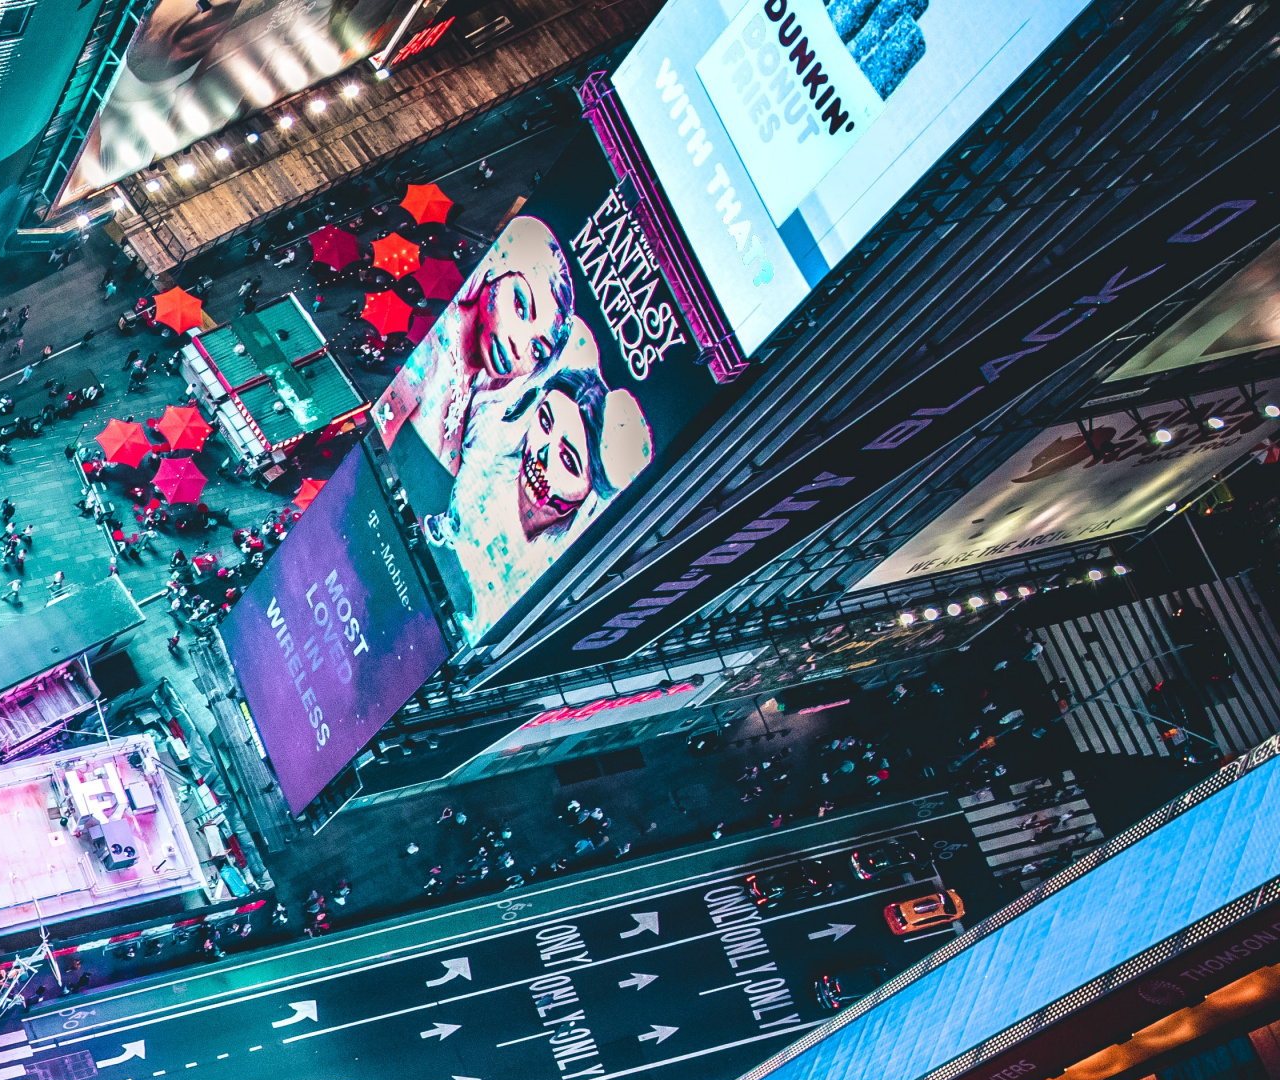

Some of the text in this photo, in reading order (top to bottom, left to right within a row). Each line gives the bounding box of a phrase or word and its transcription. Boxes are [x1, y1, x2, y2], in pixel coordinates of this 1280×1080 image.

[721, 39, 781, 143] FRIES
[742, 13, 820, 144] DONUT
[764, 0, 855, 136] DUNKIN'
[656, 57, 774, 287] WITH THAT?
[569, 217, 656, 381] MAKERS
[593, 188, 687, 362] FANTASY
[861, 263, 1167, 450] BLACK
[572, 574, 712, 651] CALL
[690, 471, 856, 566] DUTY
[906, 517, 1122, 574] WE ARE THE ARCTIC FOX
[304, 636, 324, 672] IN
[306, 582, 352, 684] LOVED
[324, 569, 369, 656] MOST
[267, 597, 330, 751] WIRELESS.
[536, 925, 592, 967] ONLY
[704, 886, 762, 928] ONLY
[720, 928, 777, 977] ONLY
[529, 976, 585, 1026] ONLY
[1180, 930, 1278, 981] THOMSON
[744, 978, 801, 1029] ONLY
[549, 1028, 605, 1080] ONLY
